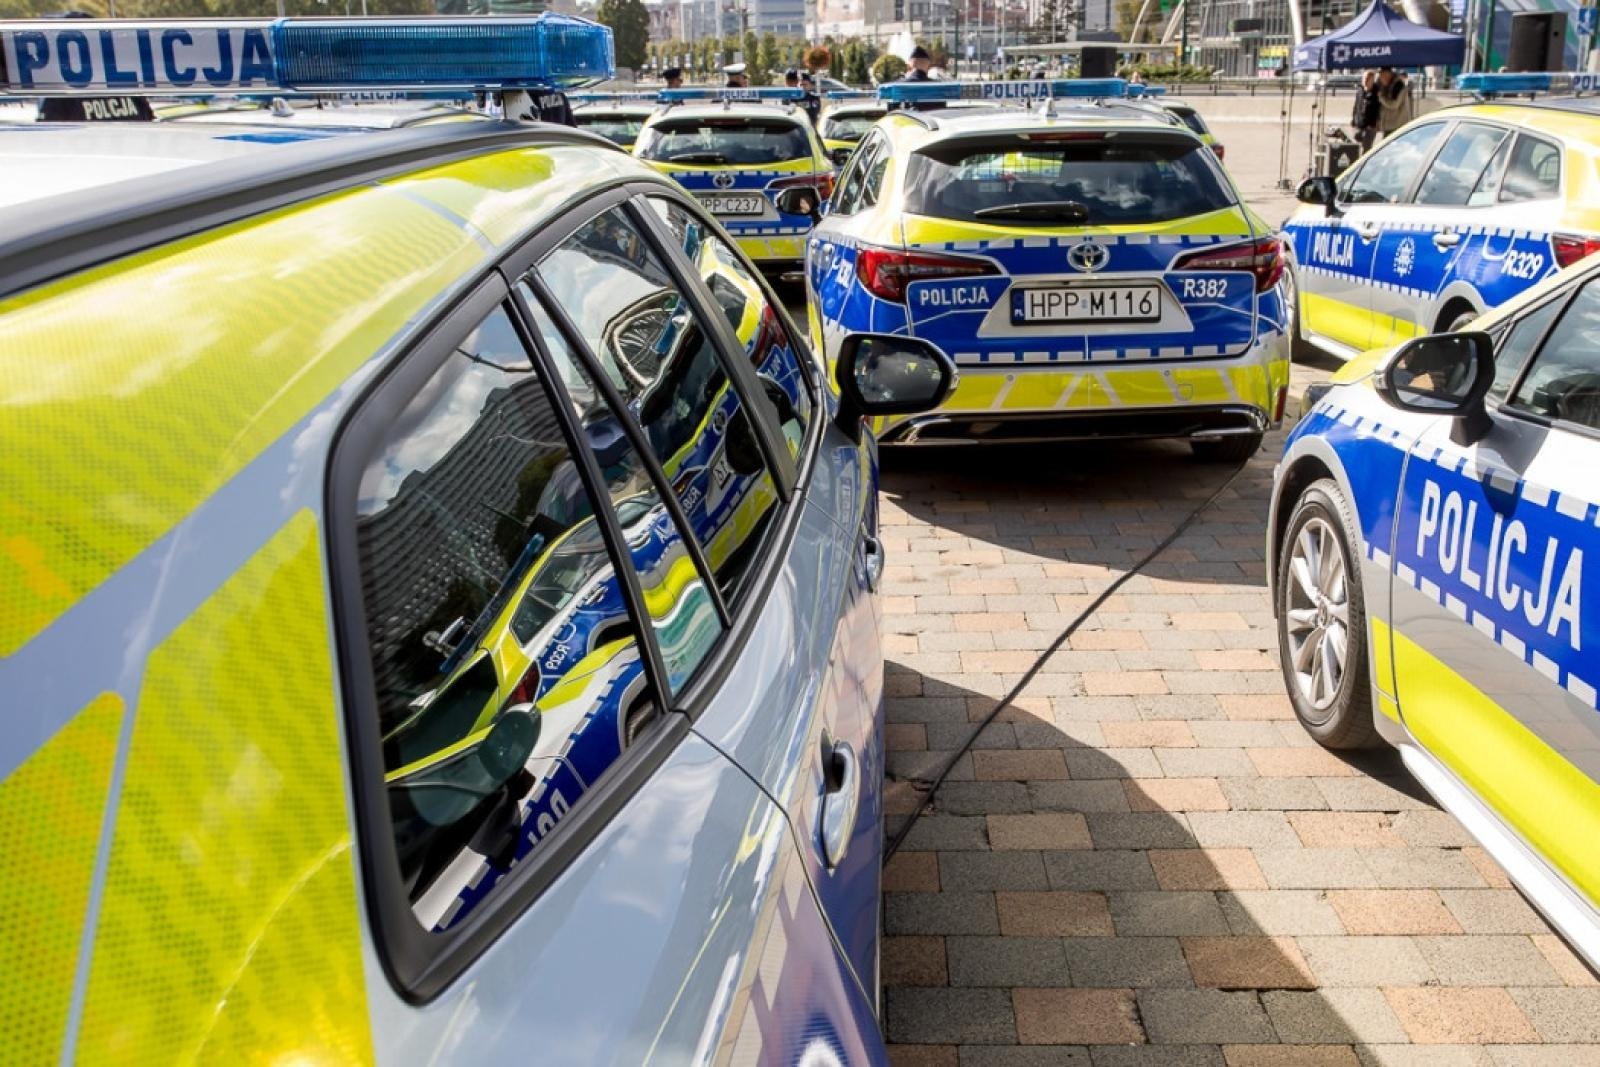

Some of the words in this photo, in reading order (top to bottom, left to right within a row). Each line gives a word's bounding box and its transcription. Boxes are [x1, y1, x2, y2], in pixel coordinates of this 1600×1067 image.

[13, 29, 277, 88] POLICJA
[1353, 46, 1392, 57] POLICJA
[983, 83, 1049, 99] POLICJA
[83, 98, 138, 119] POLCJA
[727, 199, 758, 211] C237
[1313, 231, 1354, 268] POLICJA
[1501, 250, 1544, 279] R329
[920, 286, 990, 306] POLICJA
[1183, 278, 1228, 298] R382
[1030, 292, 1080, 317] HPP
[1090, 291, 1153, 316] M116
[1417, 479, 1584, 651] POLICJA
